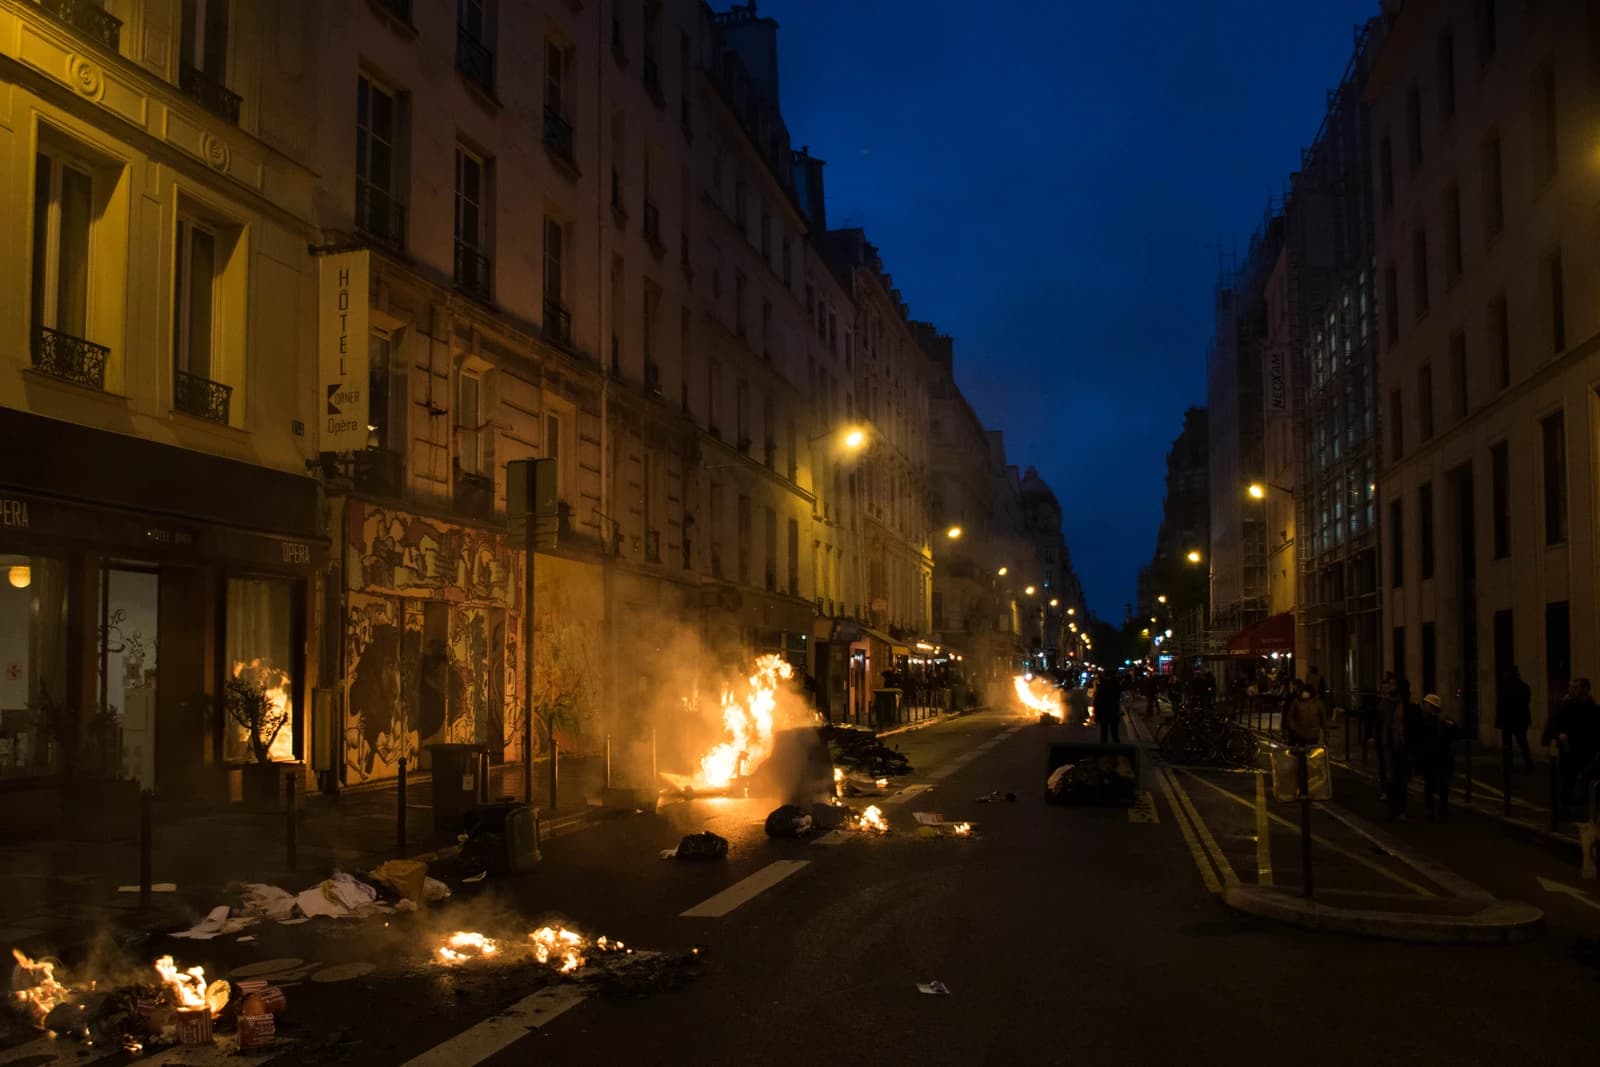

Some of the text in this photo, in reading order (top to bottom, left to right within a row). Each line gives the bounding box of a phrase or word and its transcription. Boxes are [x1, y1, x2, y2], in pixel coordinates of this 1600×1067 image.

[339, 269, 349, 376] HÔTEL
[1271, 352, 1284, 409] NEOXAM
[282, 542, 310, 565] OPERA
